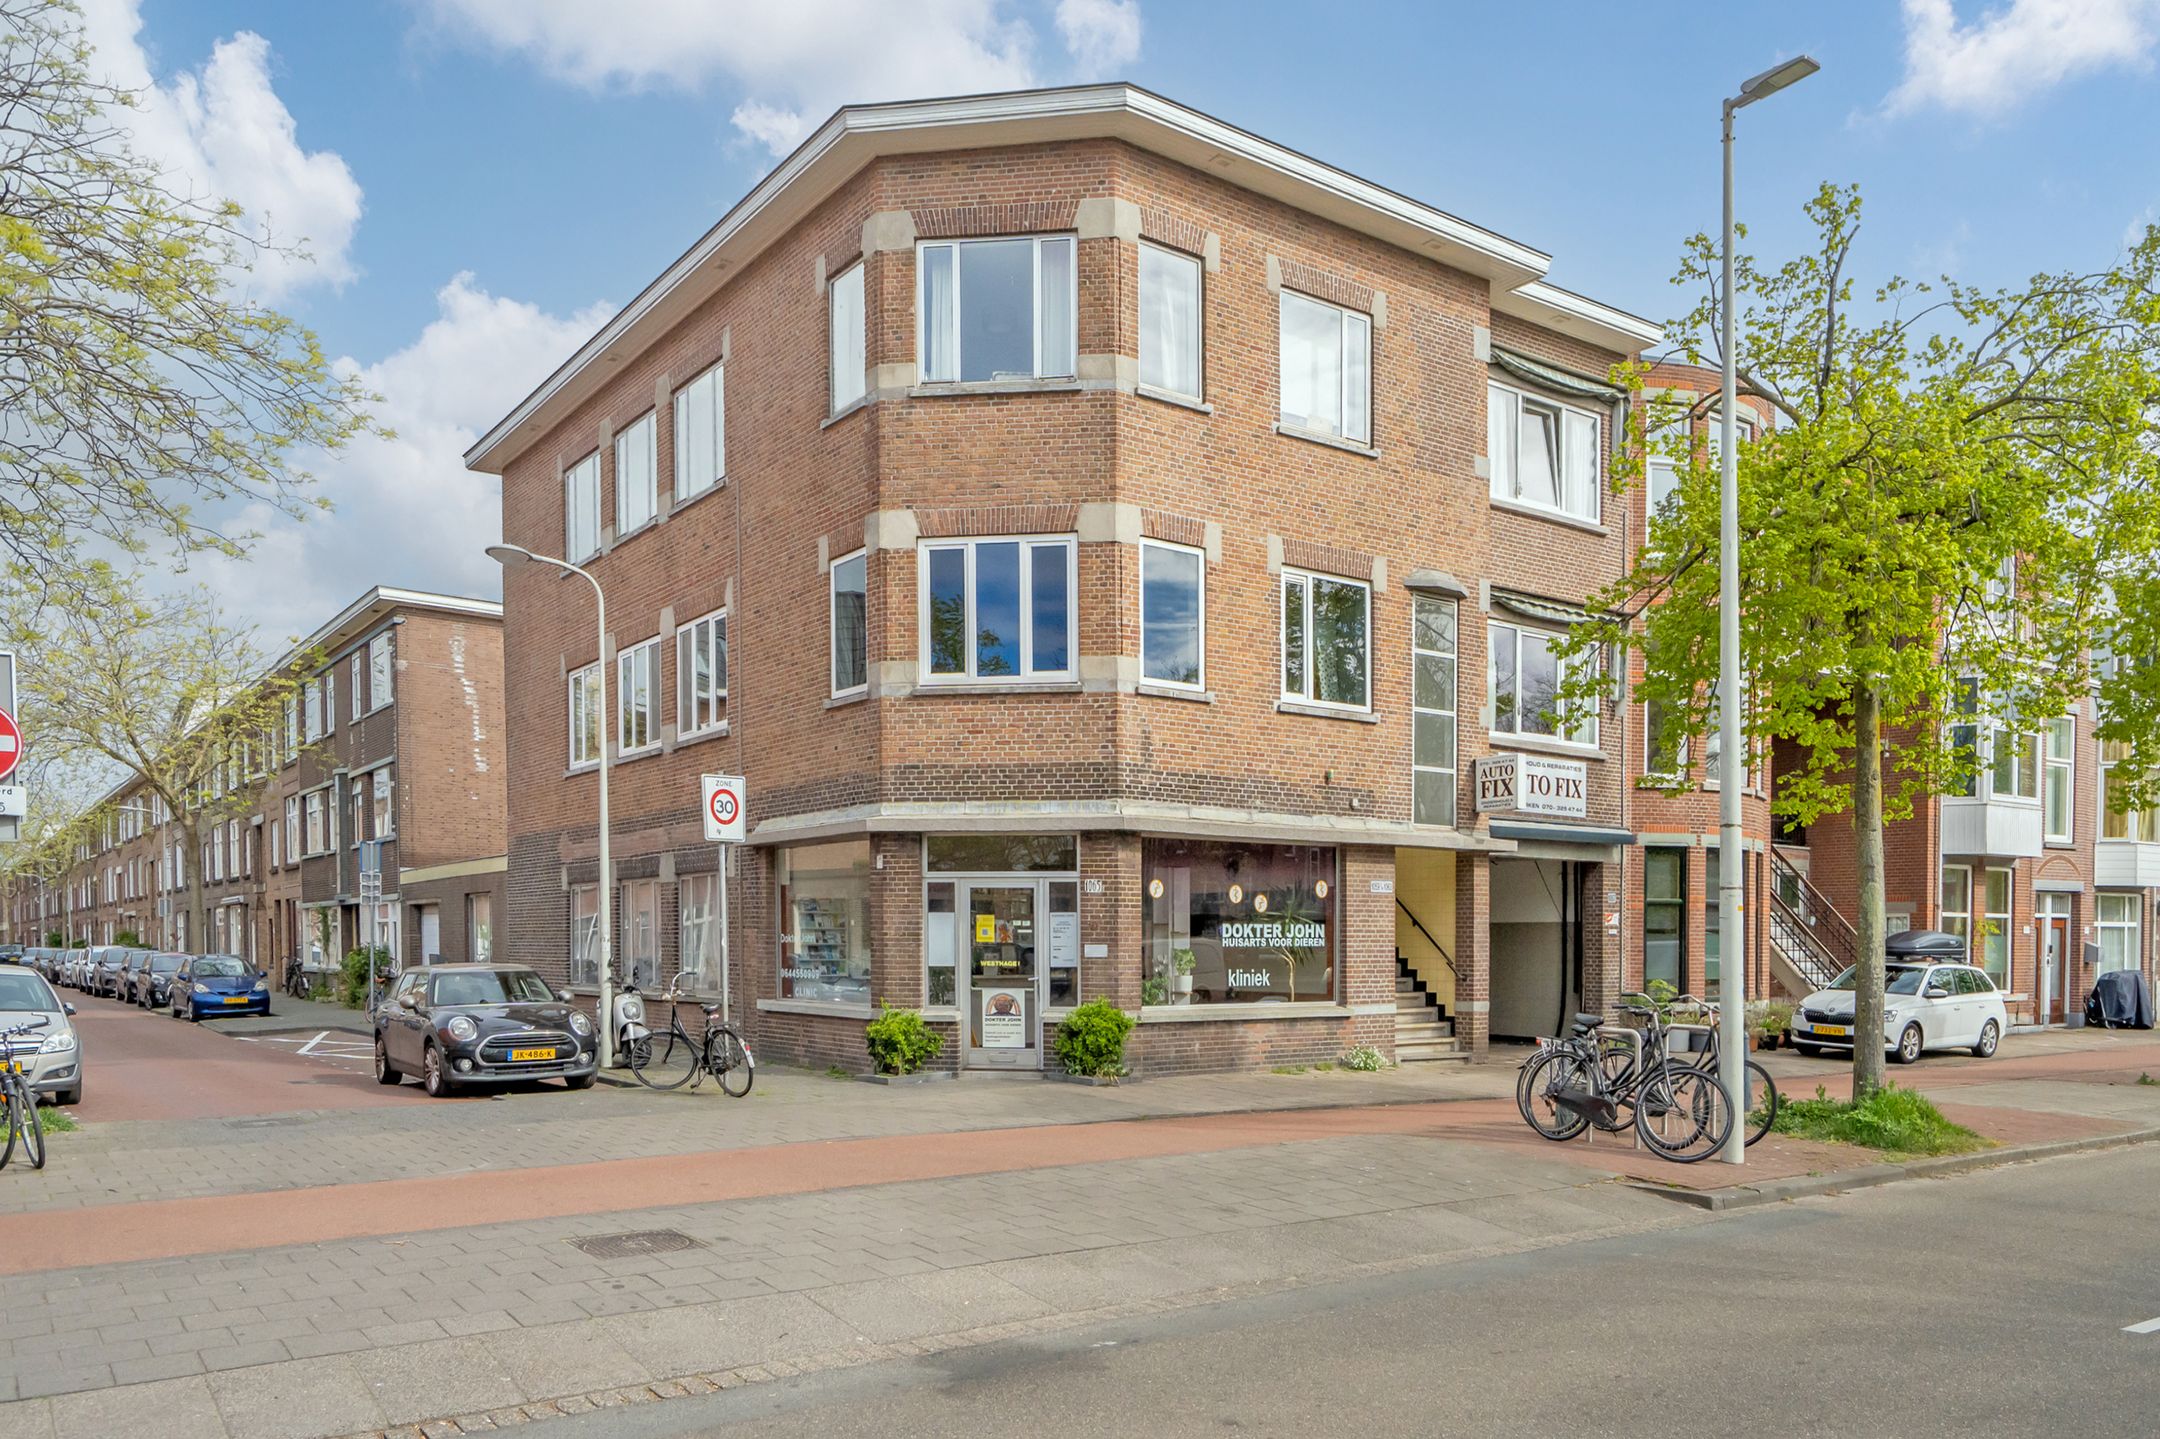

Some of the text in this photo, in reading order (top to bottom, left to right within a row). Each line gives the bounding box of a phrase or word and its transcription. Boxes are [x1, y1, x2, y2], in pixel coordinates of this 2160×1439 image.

[1526, 760, 1541, 768] OUD
[1480, 764, 1514, 779] AUTO
[715, 779, 733, 787] ZONE
[1480, 777, 1514, 799] FIX
[1526, 773, 1583, 799] TO FIX
[715, 800, 734, 814] 30
[1222, 923, 1325, 938] DOKTER JOHN
[1222, 938, 1325, 947] HUISARTS VOOR DIEREN
[1228, 968, 1270, 987] kliniek
[514, 1050, 553, 1059] JK-486-K
